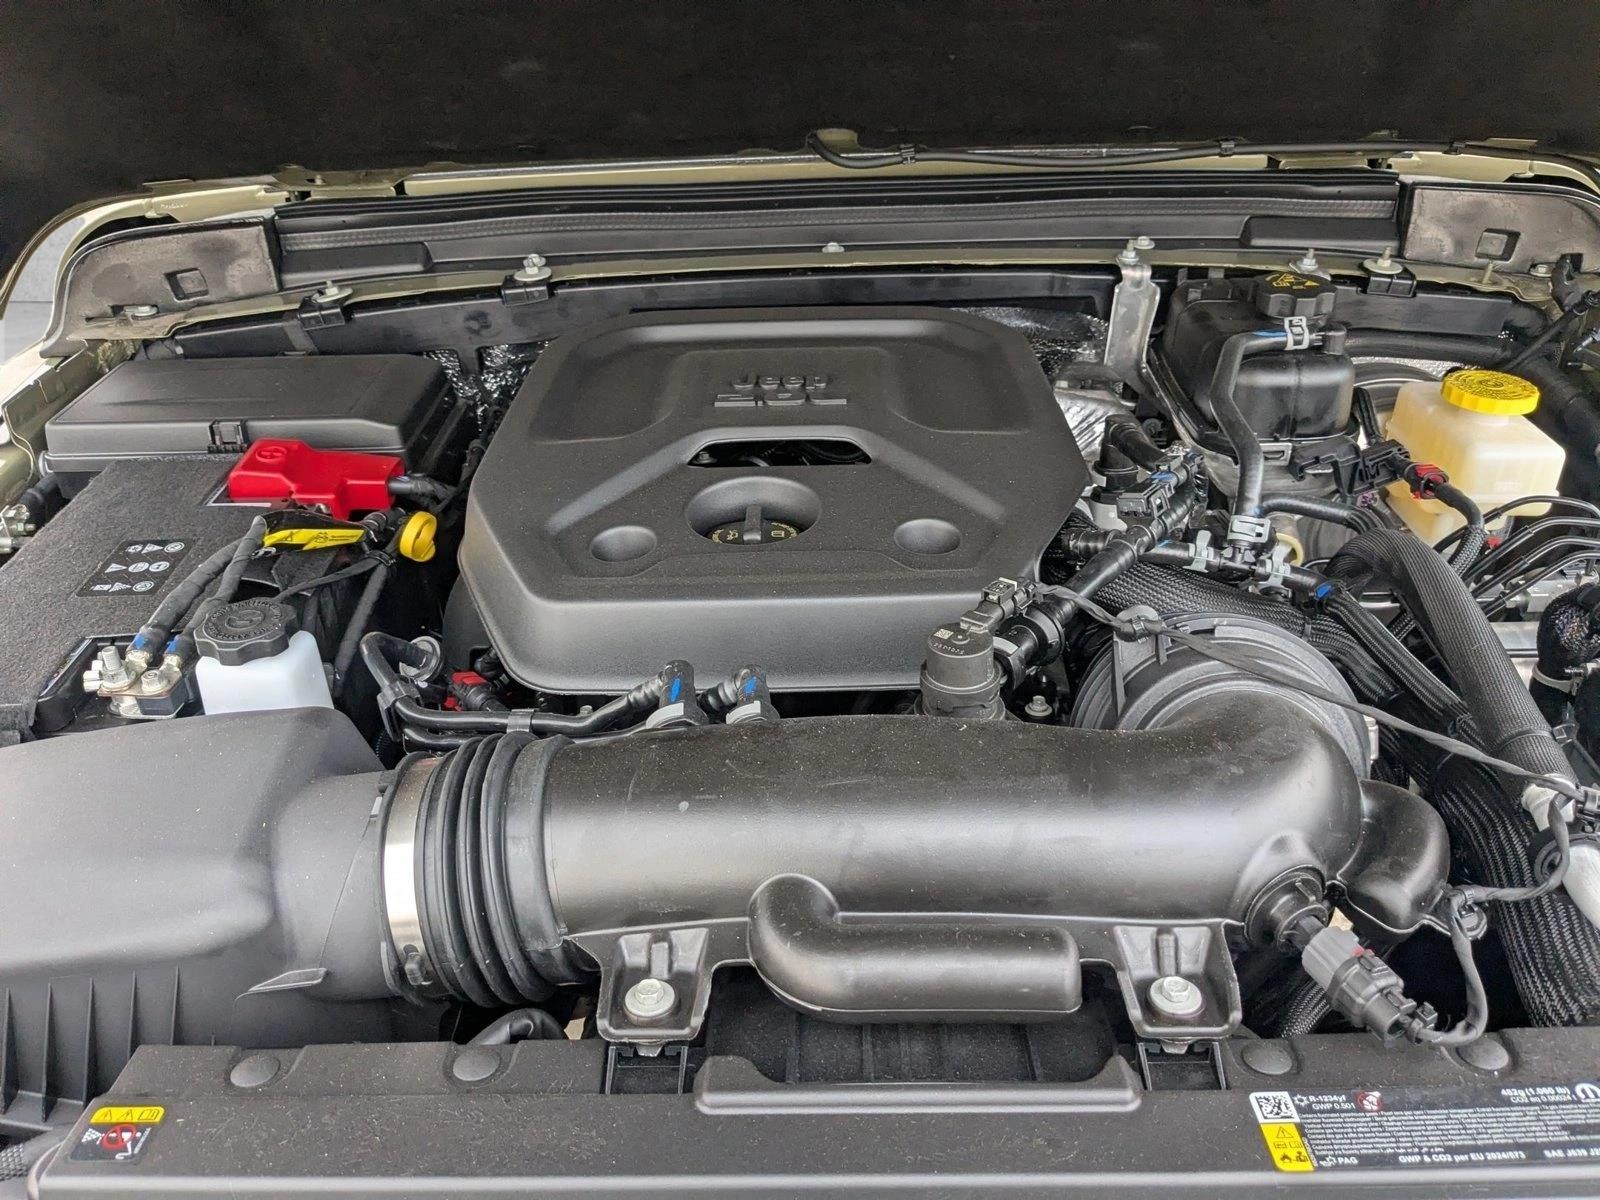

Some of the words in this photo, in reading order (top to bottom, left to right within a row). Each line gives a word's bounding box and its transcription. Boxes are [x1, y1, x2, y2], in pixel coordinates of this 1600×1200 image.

[732, 374, 832, 391] Jeep
[1337, 1156, 1358, 1164] PAG
[1398, 1154, 1421, 1163] GWP
[1432, 1153, 1453, 1162] CO2
[1453, 1154, 1470, 1163] per
[1469, 1152, 1484, 1161] EU
